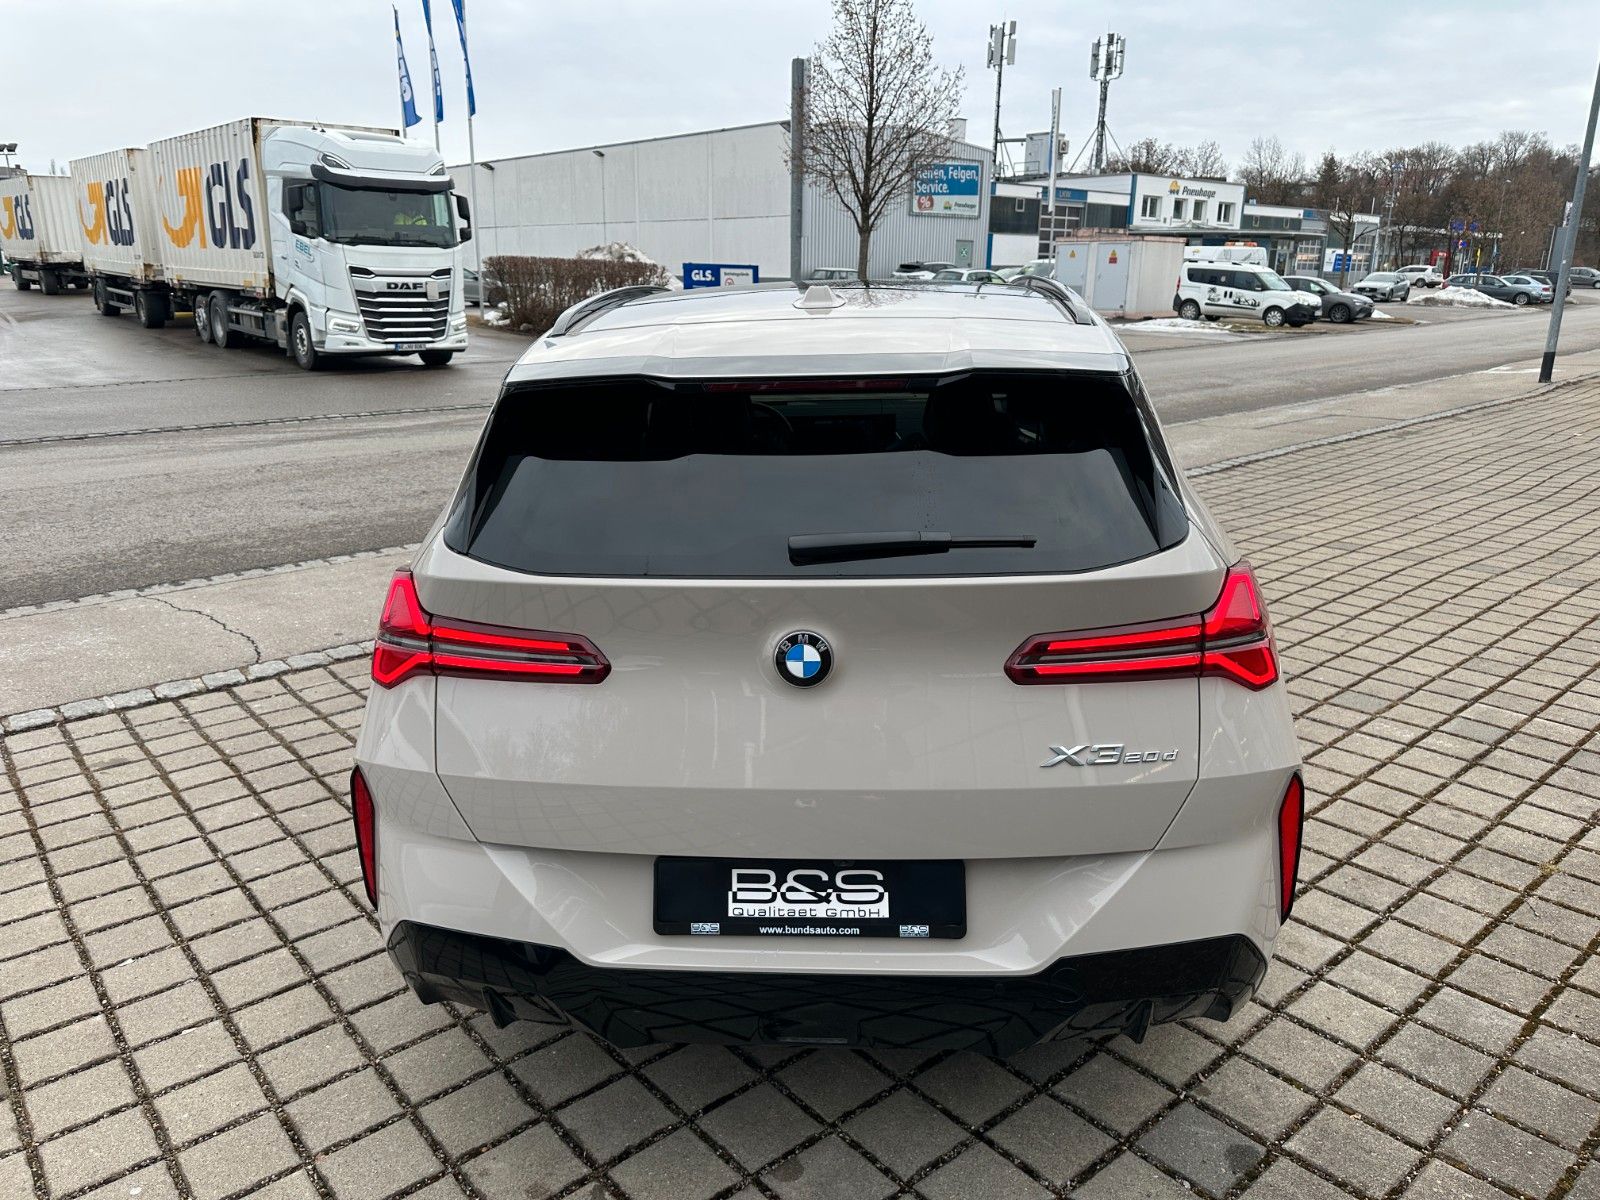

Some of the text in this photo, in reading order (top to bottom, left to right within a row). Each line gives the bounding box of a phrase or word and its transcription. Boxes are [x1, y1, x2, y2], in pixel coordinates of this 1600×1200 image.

[948, 165, 978, 183] Felgen,
[916, 181, 950, 194] Service.
[1181, 186, 1217, 199] Pneuhage
[105, 178, 135, 246] GLS
[205, 158, 256, 250] GLS
[14, 194, 35, 240] GLS
[386, 282, 424, 291] DAF
[780, 634, 828, 653] BMW
[731, 868, 885, 905] B&S
[732, 906, 818, 918] Qualitaet
[759, 925, 860, 936] www.bundsauto.com
